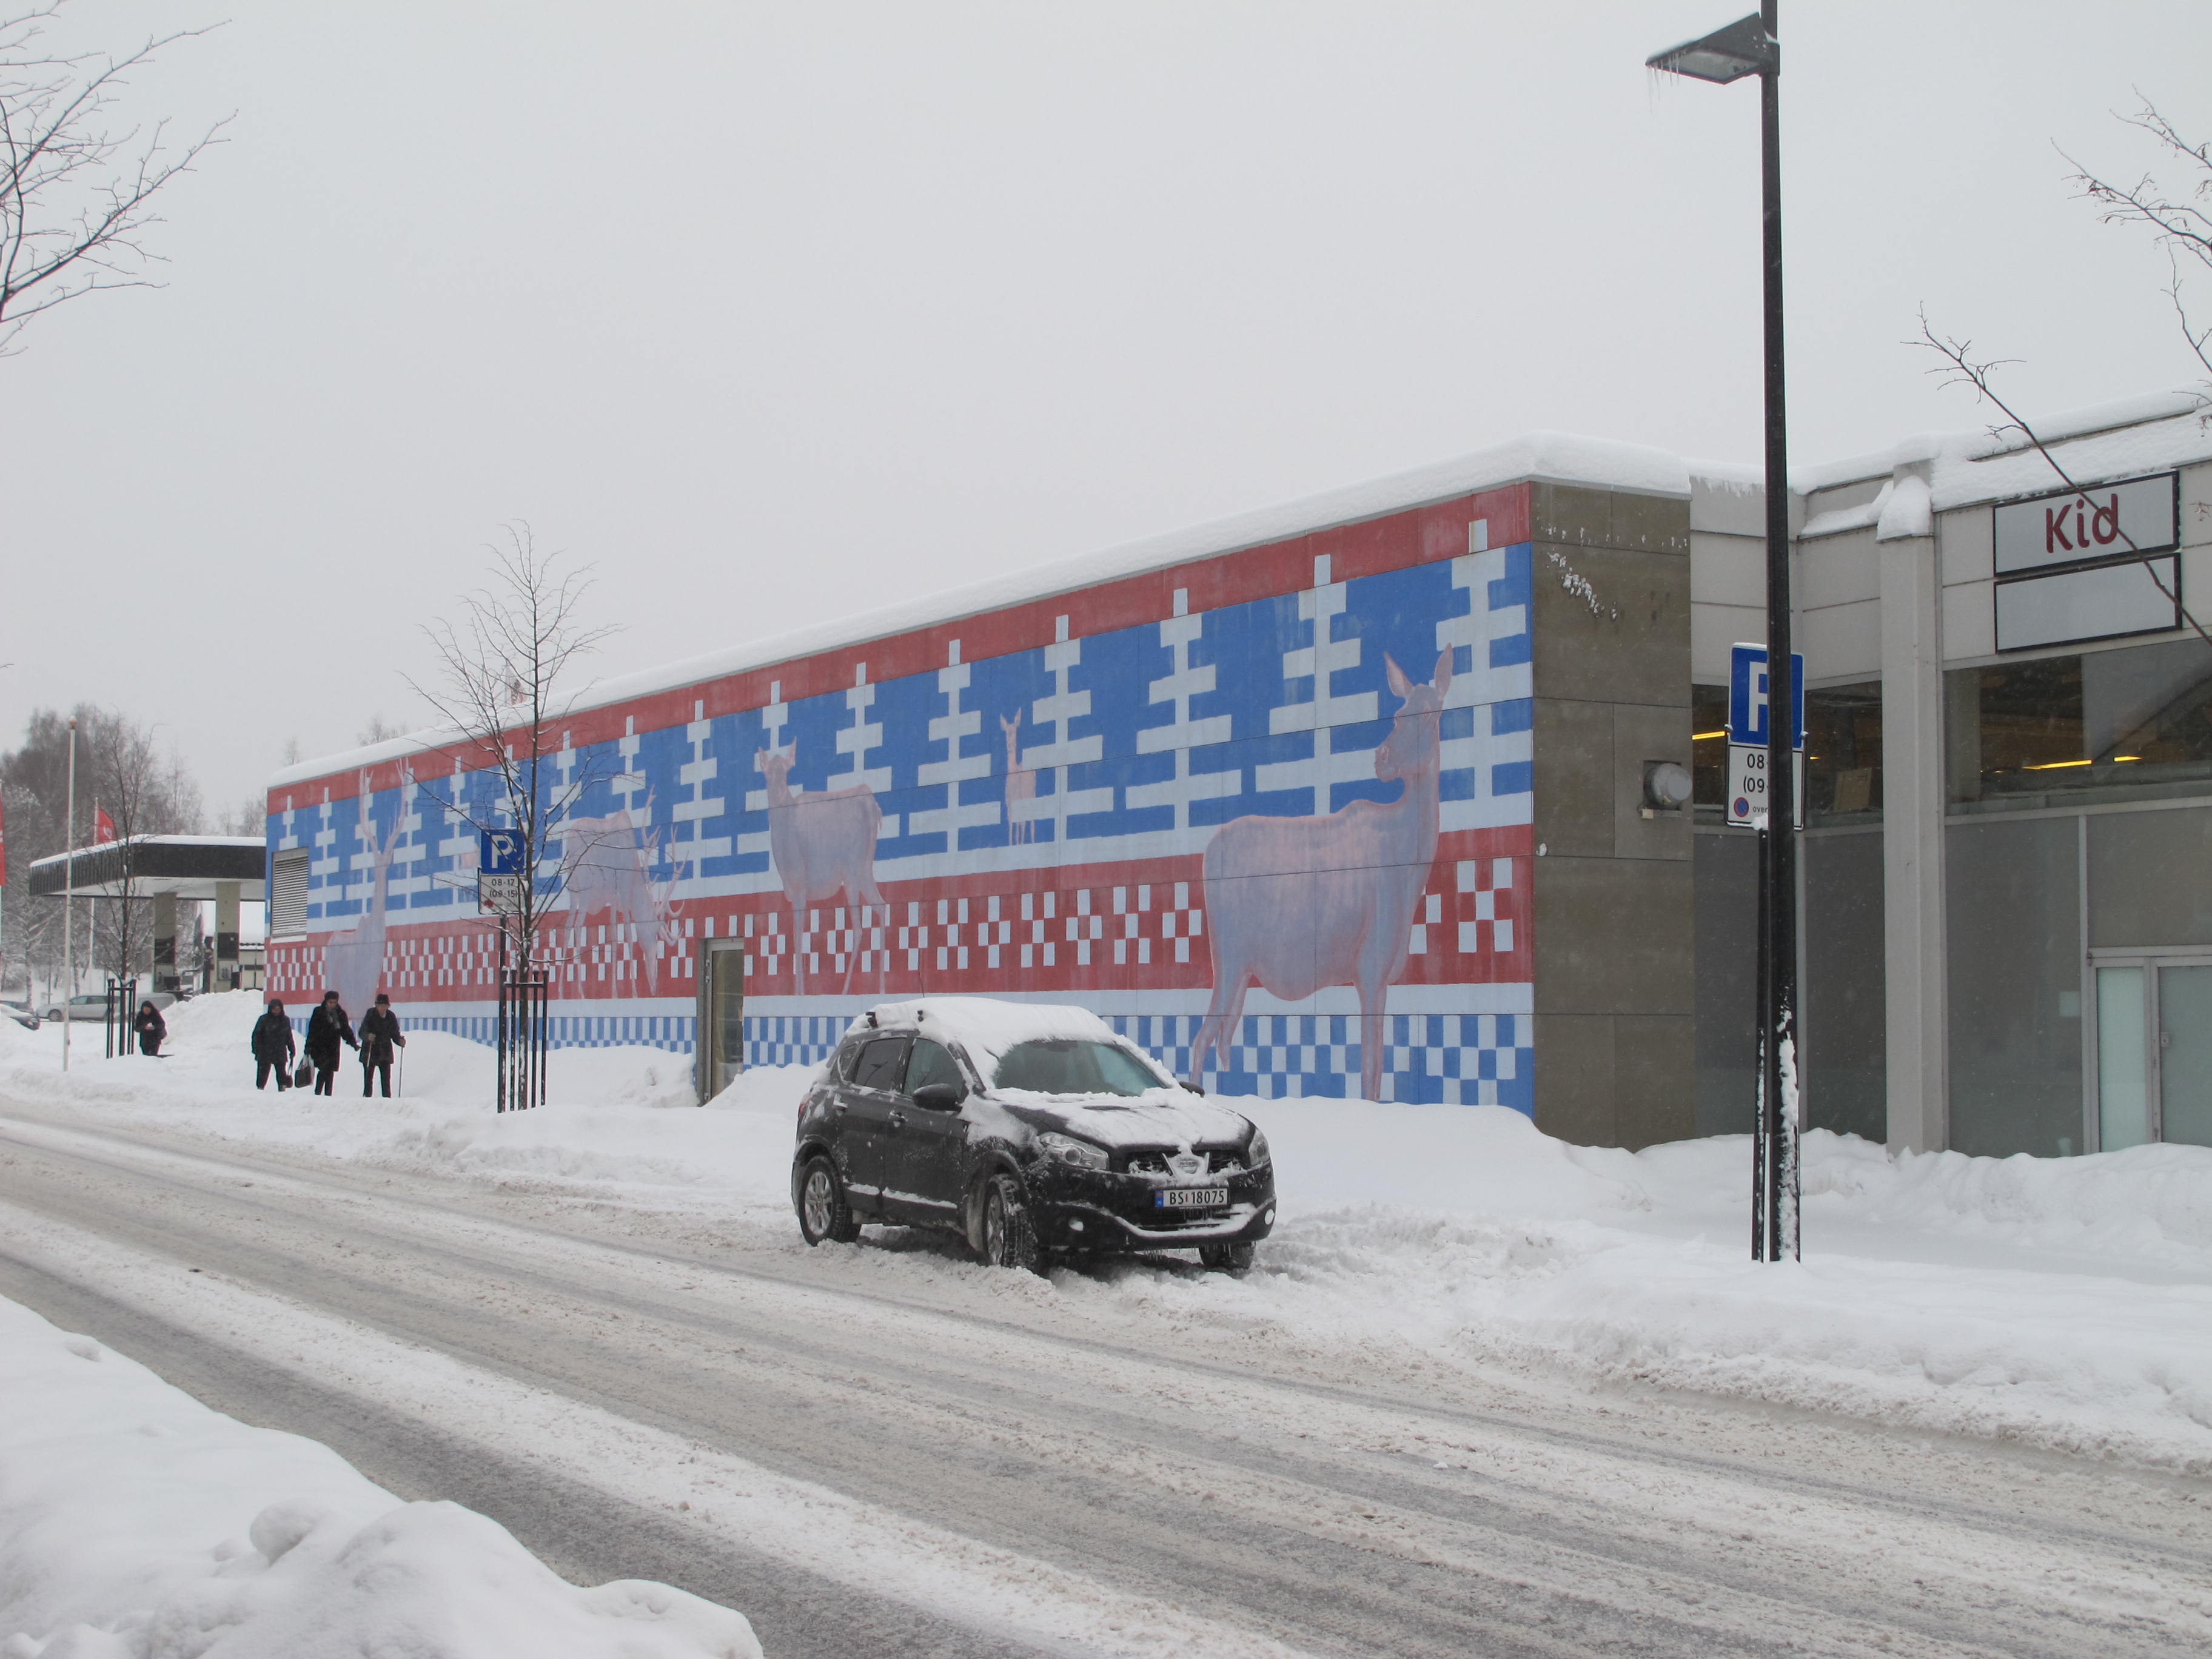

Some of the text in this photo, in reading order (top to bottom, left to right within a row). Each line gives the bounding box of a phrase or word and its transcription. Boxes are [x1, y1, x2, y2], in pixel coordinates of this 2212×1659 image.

[2045, 493, 2118, 554] Kid
[1746, 753, 1768, 769] 08
[1743, 776, 1768, 794] (09
[491, 835, 515, 868] P
[1169, 1190, 1224, 1205] BS 18075
